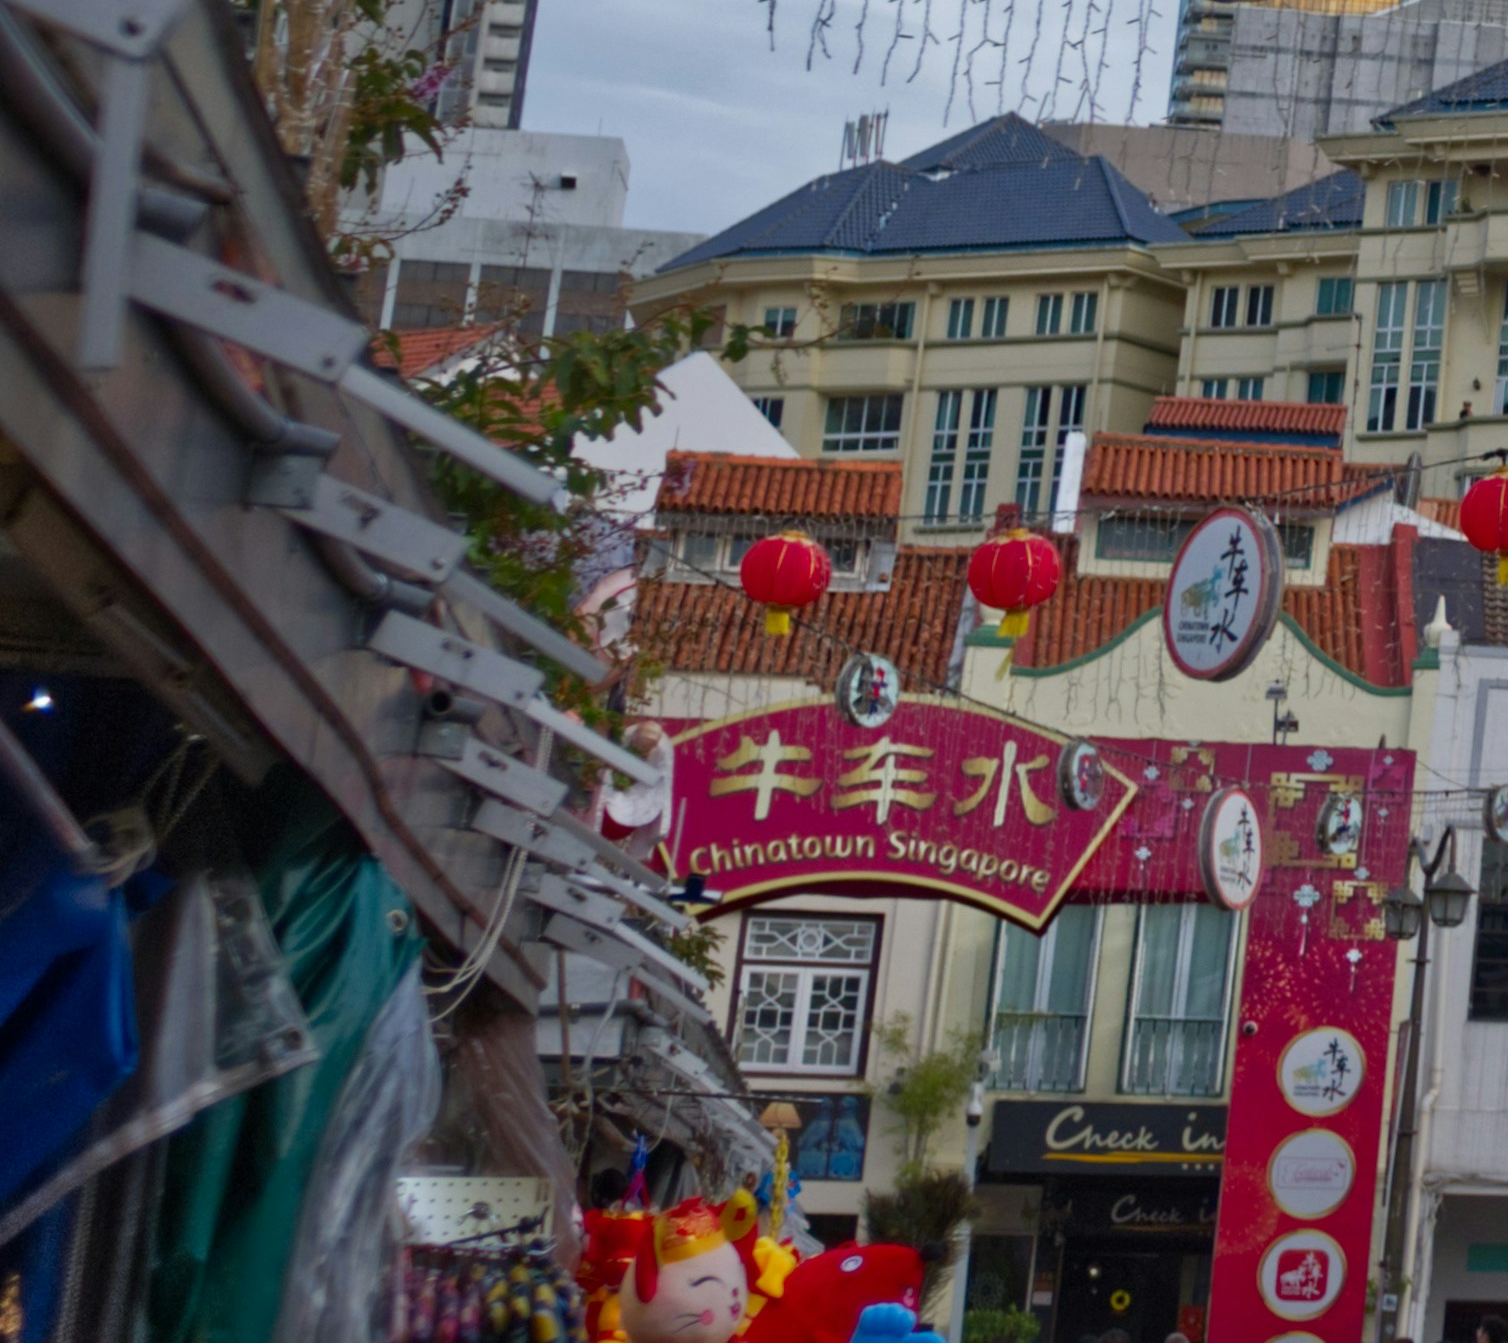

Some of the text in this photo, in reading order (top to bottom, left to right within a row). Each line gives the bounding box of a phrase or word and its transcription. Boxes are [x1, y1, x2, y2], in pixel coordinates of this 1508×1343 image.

[708, 729, 1059, 828] 牛车水
[689, 830, 1052, 893] Chinatown Singapore
[1045, 1105, 1158, 1150] Check
[1111, 1195, 1182, 1223] Check
